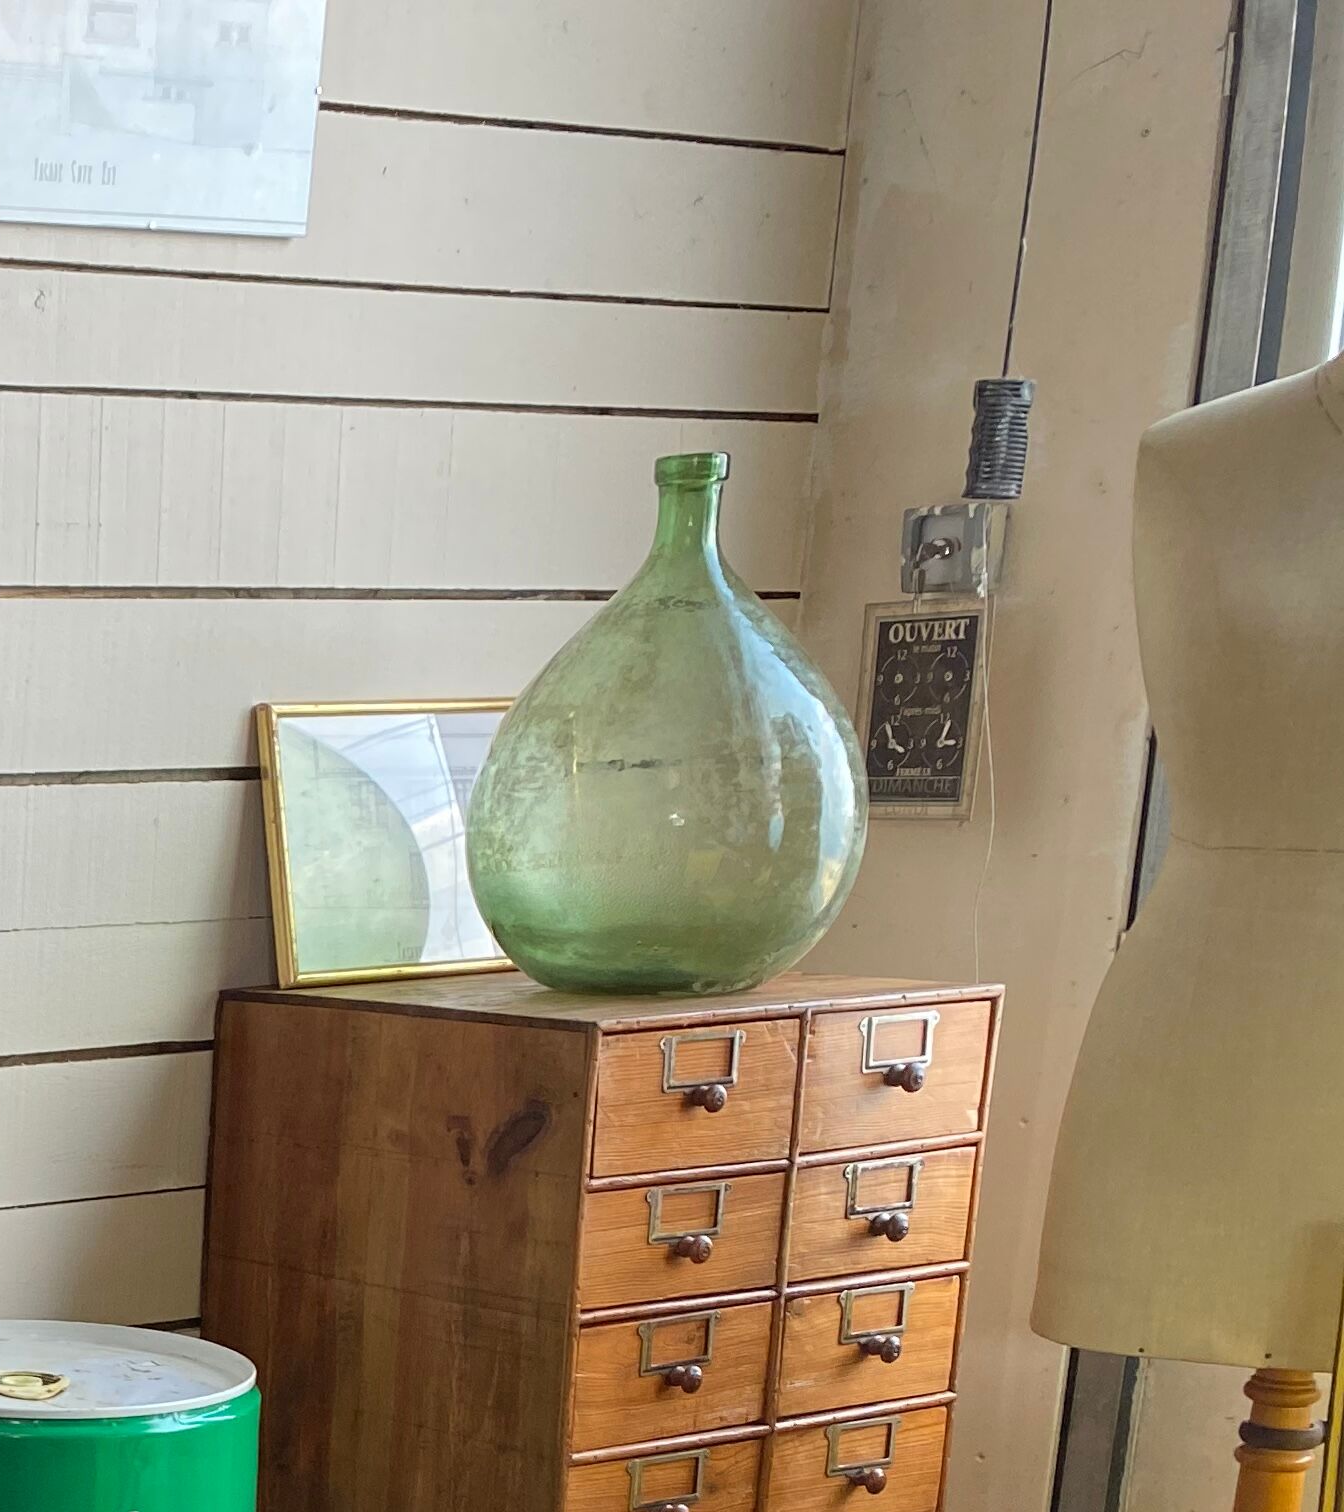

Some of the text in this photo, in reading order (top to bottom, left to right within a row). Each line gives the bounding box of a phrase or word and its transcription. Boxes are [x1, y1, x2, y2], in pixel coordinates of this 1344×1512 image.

[889, 618, 970, 644] OUVERT
[897, 649, 908, 661] 12
[946, 645, 958, 658] 12
[963, 670, 970, 682] 3
[871, 739, 877, 750] 9
[907, 738, 914, 749] 3
[920, 738, 927, 749] 9
[887, 760, 894, 770] 6
[937, 759, 943, 770] 6
[871, 779, 953, 793] DIMANCHE
